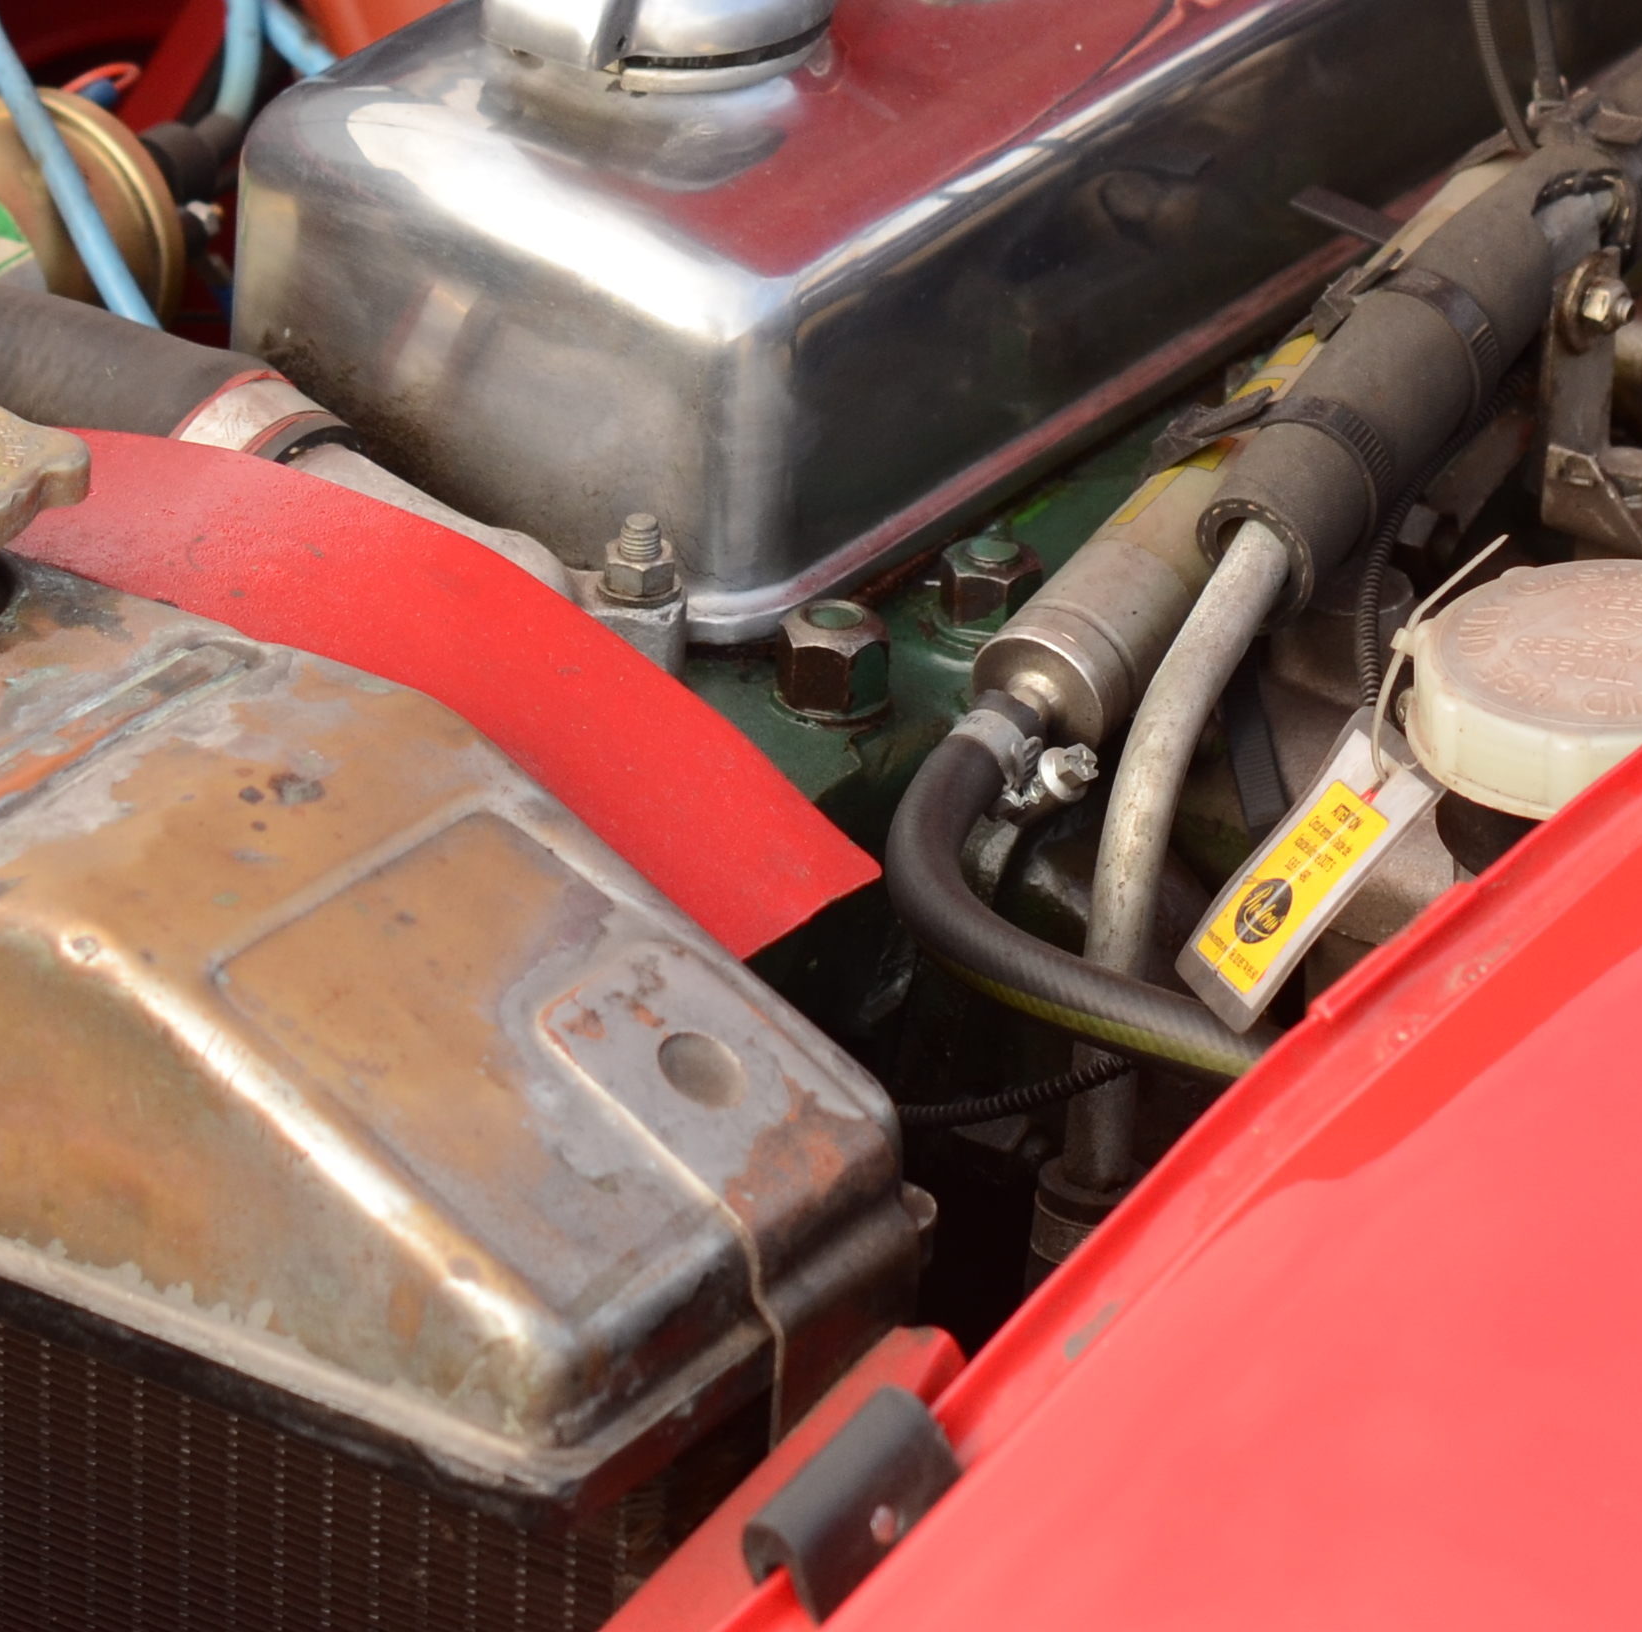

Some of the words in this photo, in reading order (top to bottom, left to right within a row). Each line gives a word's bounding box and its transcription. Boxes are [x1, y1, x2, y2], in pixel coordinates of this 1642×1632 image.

[1457, 605, 1511, 658] ONLY
[1472, 657, 1557, 707] USE
[1550, 660, 1634, 687] FULL
[1331, 802, 1364, 833] ATTENTON
